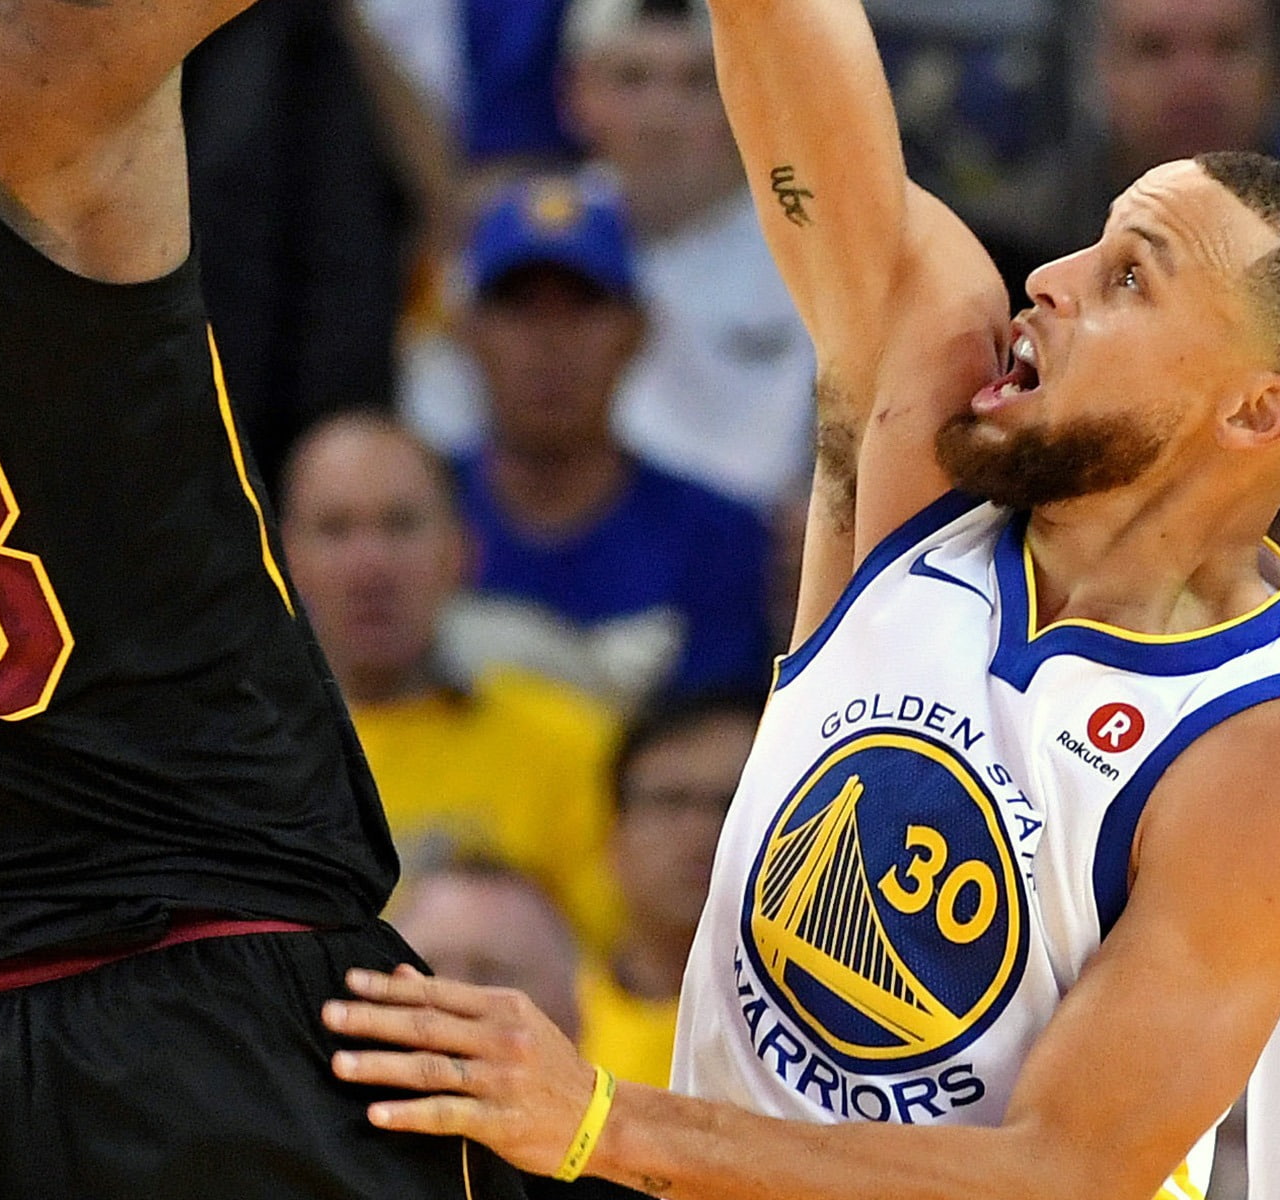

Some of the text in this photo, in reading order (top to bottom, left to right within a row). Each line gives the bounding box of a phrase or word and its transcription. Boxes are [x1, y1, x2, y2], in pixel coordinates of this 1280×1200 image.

[821, 693, 986, 751] GOLDEN
[1097, 710, 1132, 748] R
[1055, 730, 1120, 782] Rakuten
[877, 824, 998, 944] 30
